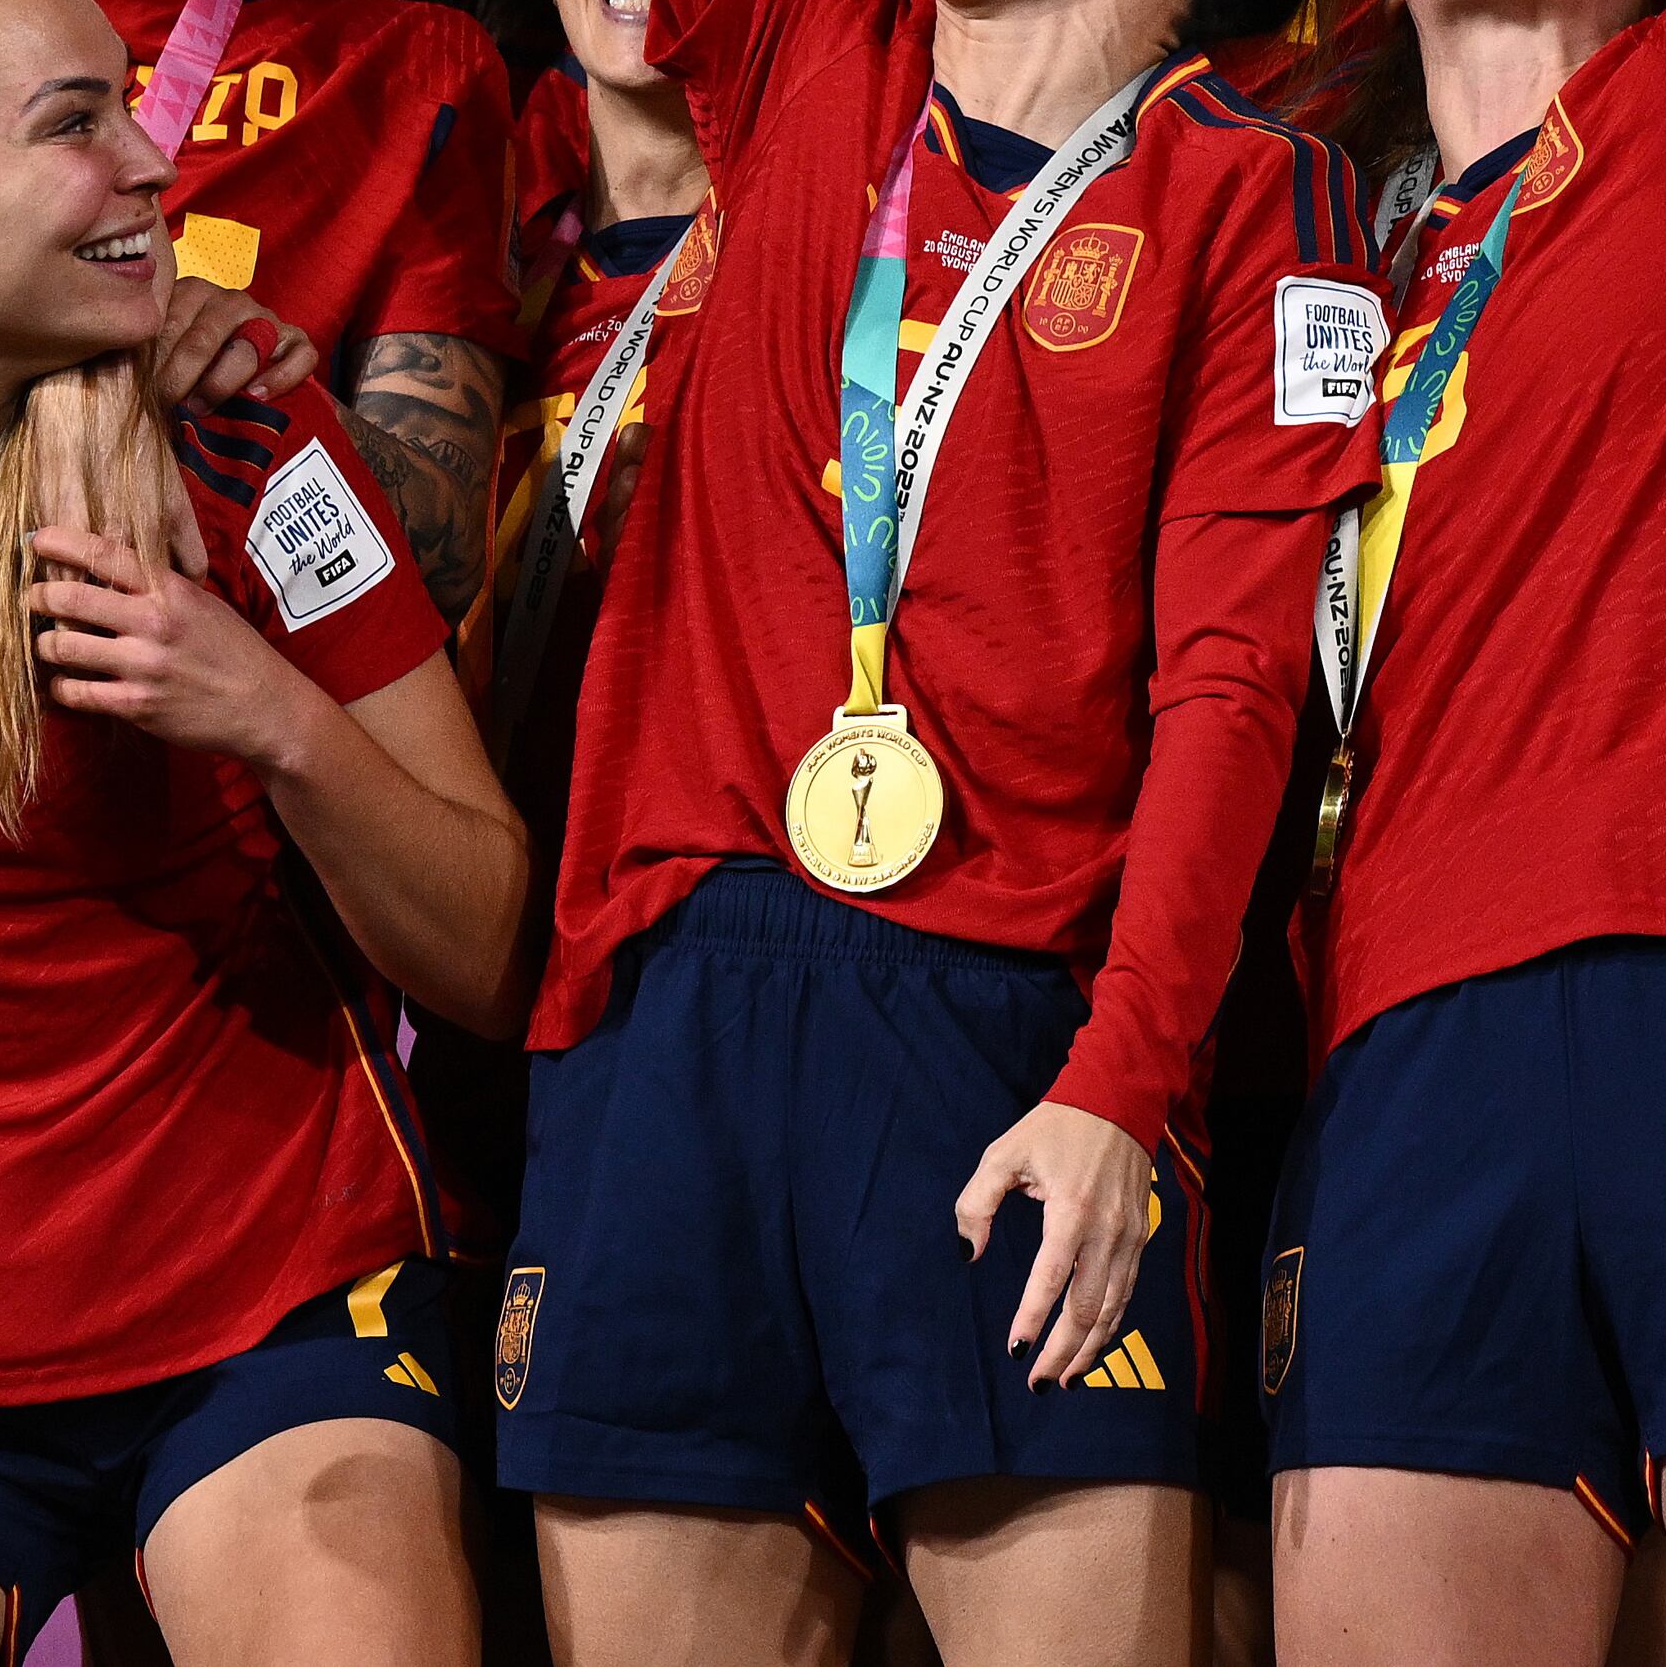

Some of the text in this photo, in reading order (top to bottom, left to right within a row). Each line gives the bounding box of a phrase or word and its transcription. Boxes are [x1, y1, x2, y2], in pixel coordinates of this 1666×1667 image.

[1033, 132, 1119, 215] WOMEN'S
[1394, 177, 1417, 214] CUP
[923, 240, 981, 263] 20 AUGUST
[941, 230, 986, 253] ENGLAN
[983, 217, 1043, 293] WORLD
[1439, 242, 1479, 261] ENGLAN
[941, 255, 975, 274] SYDNE
[1436, 255, 1471, 274] AUGUS
[1441, 270, 1465, 283] SYD
[958, 296, 989, 341] CUP
[1306, 304, 1371, 329] FOOTBALL
[1307, 323, 1373, 354] UNITES
[598, 329, 651, 401] WORLD
[1300, 351, 1370, 375] the Worl
[1328, 382, 1357, 395] FIFA
[579, 405, 605, 450] CUP
[263, 477, 325, 533] FOOTBALL
[275, 494, 339, 554] UNITES
[289, 513, 355, 576] the World
[321, 556, 351, 582] FIFA
[827, 729, 874, 751] WOMEN'S
[877, 729, 911, 751] WORLD
[910, 749, 928, 767] CUP
